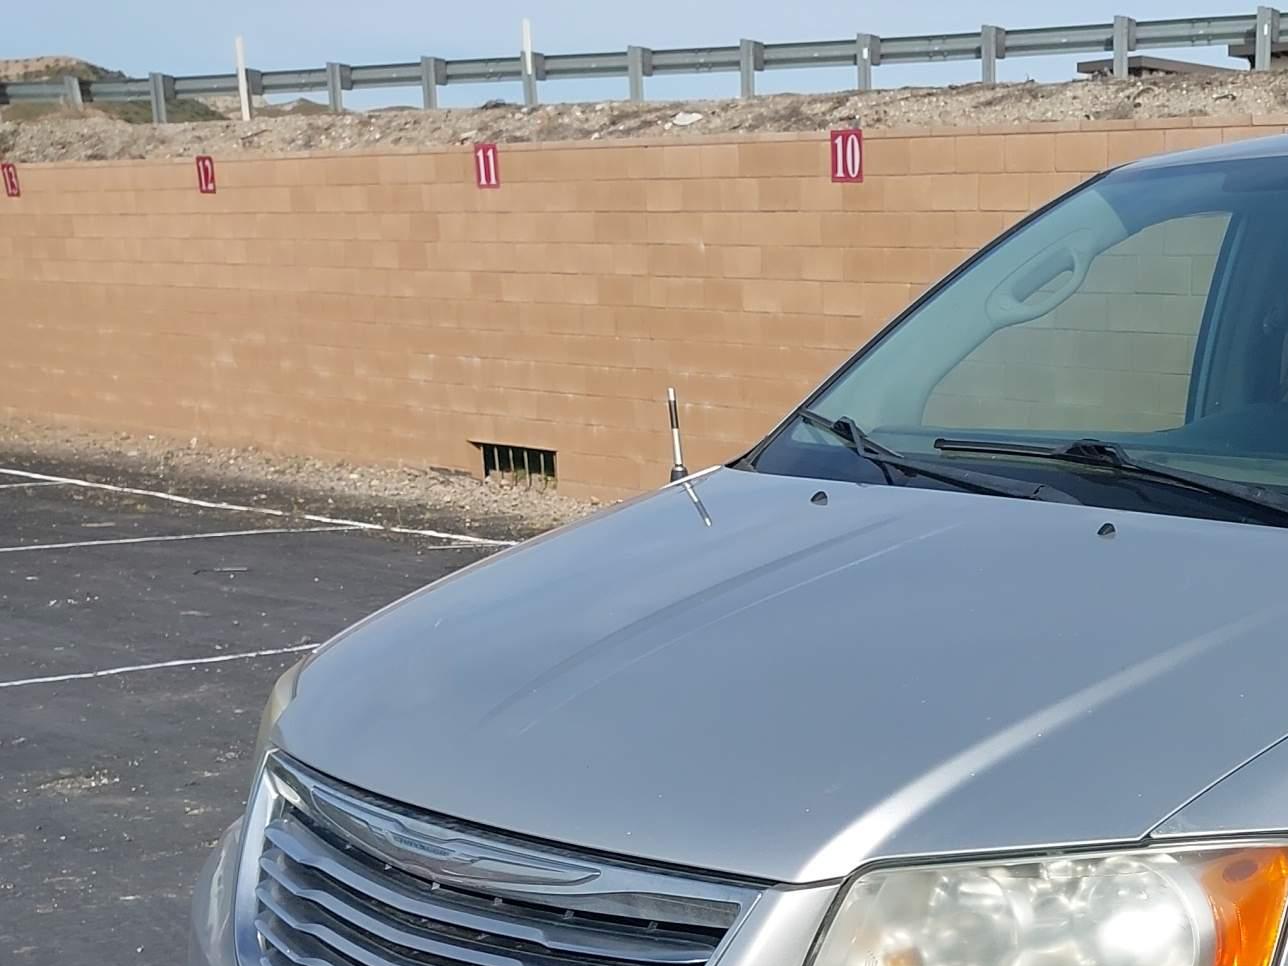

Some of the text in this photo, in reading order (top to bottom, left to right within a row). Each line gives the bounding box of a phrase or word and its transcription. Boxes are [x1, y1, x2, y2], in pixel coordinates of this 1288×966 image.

[475, 148, 497, 185] 11
[834, 134, 862, 178] 10
[2, 164, 18, 195] 13
[198, 159, 214, 191] 12
